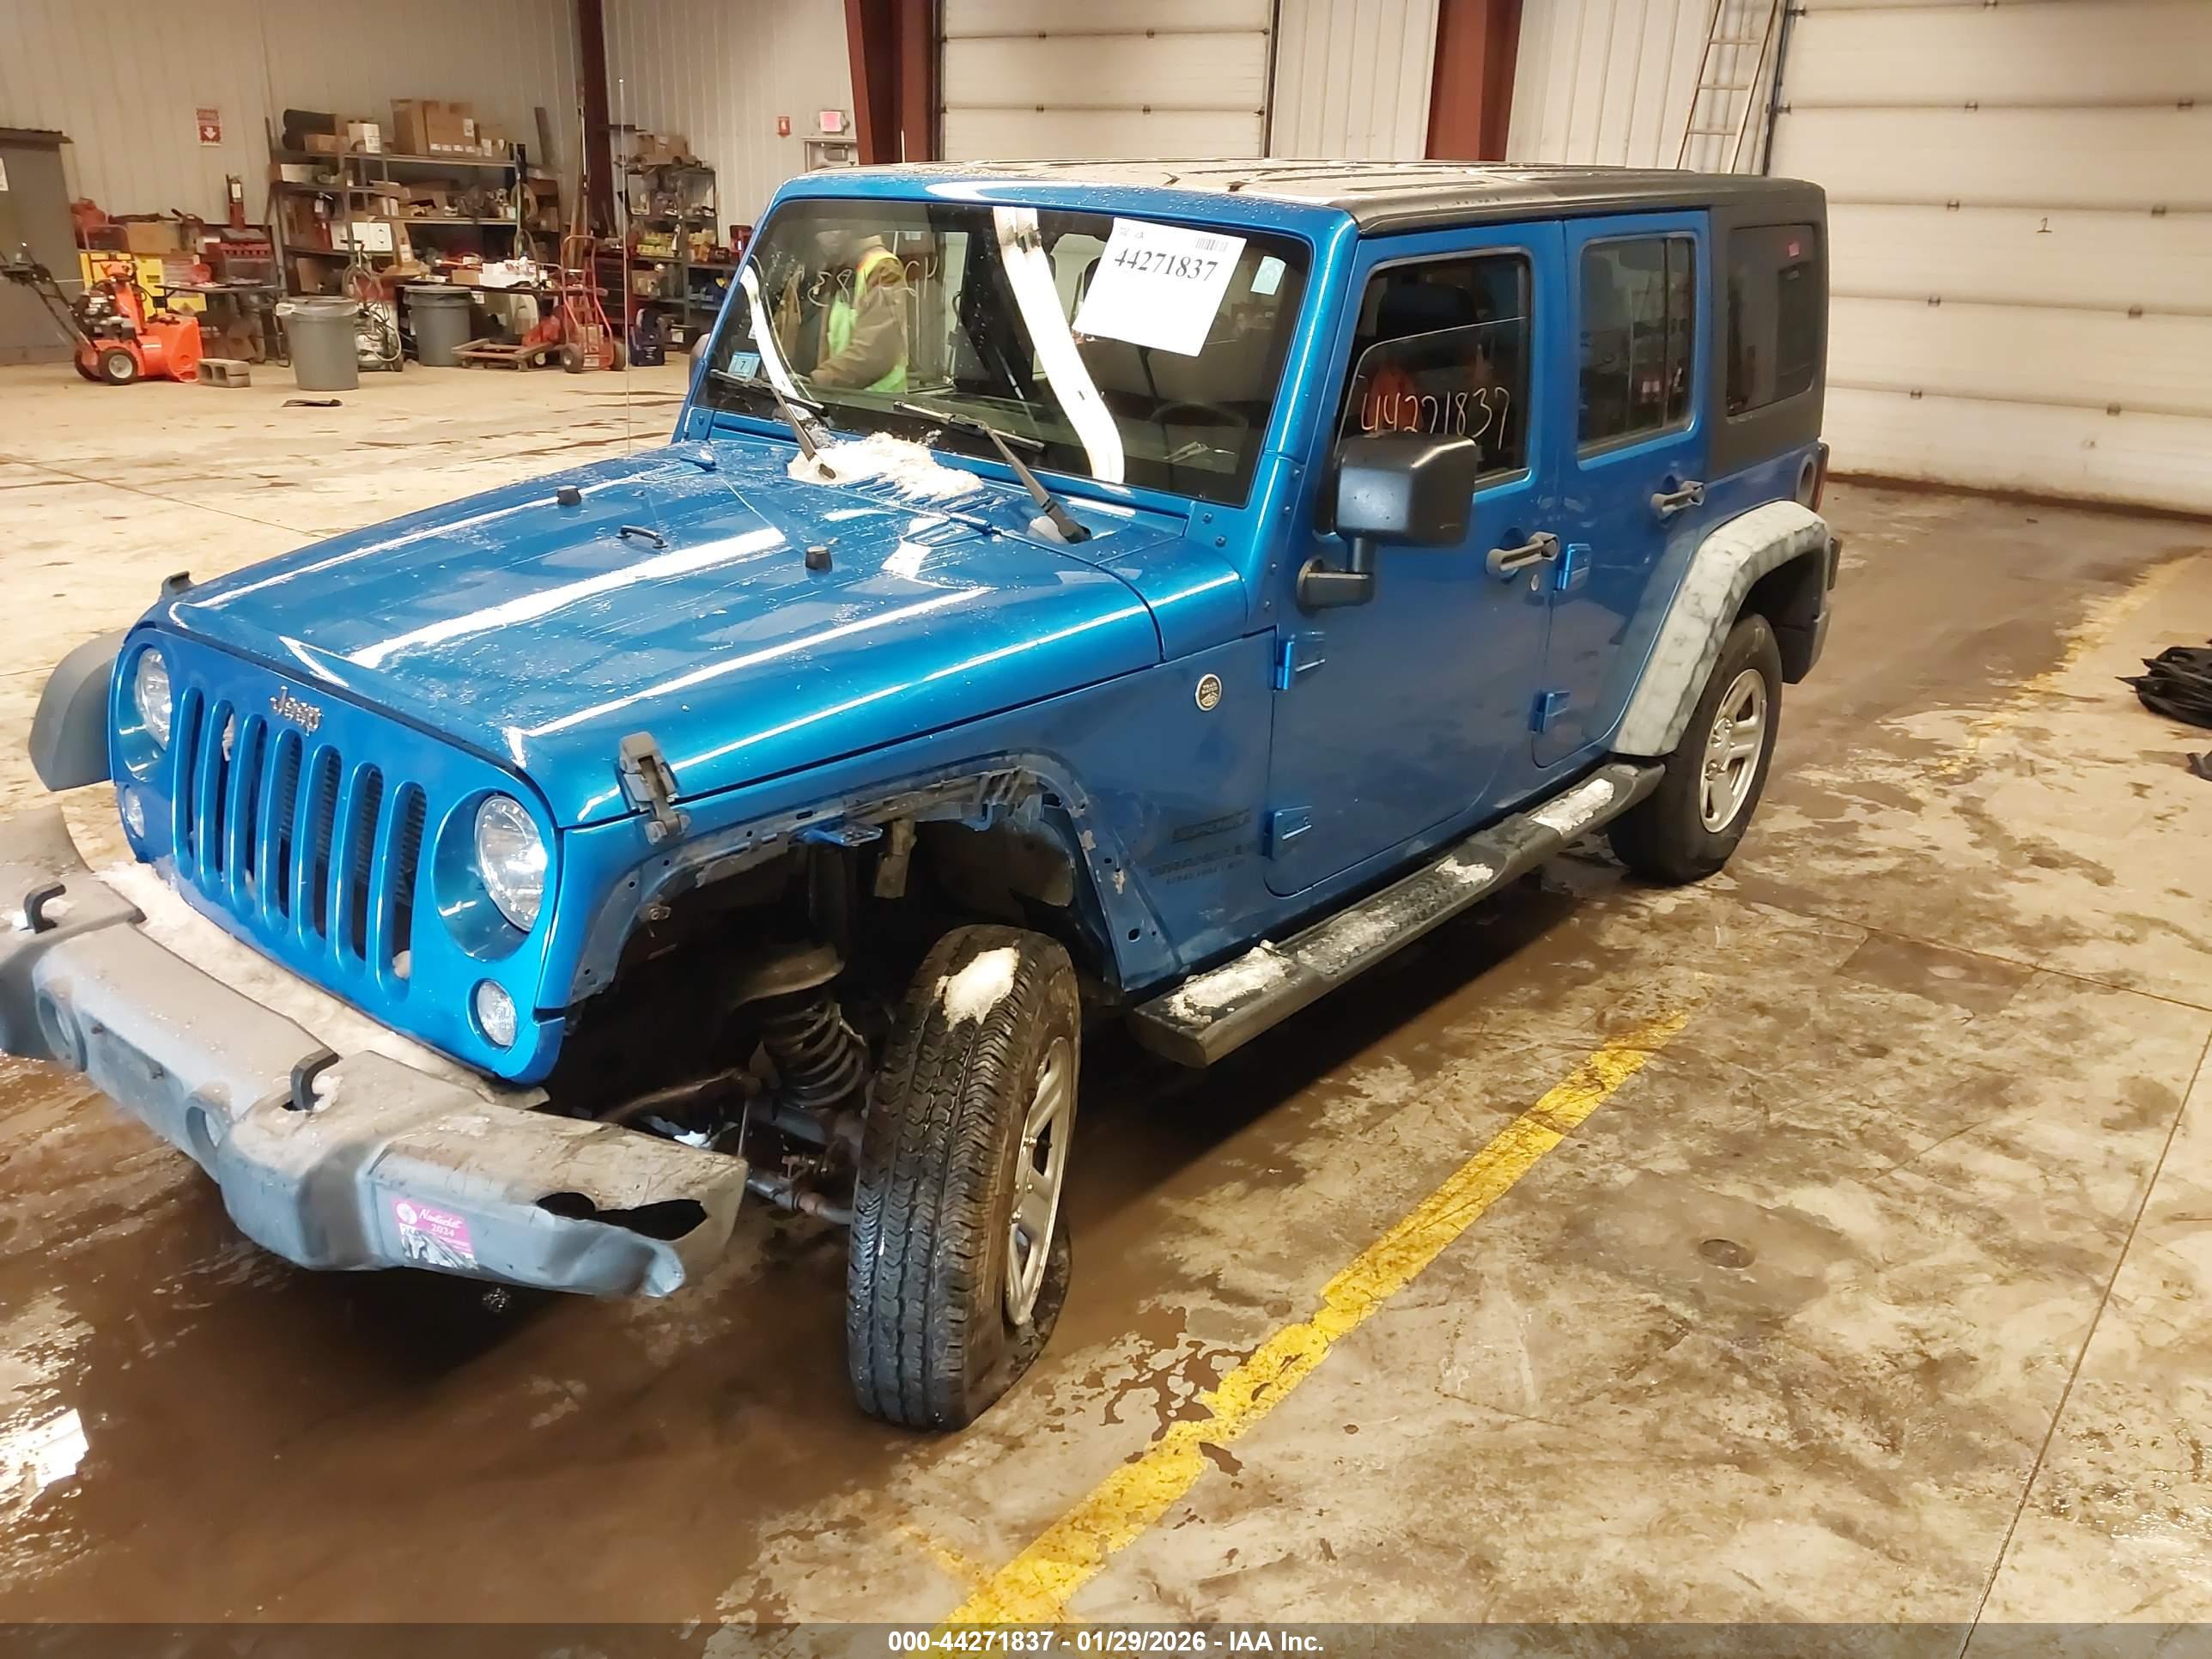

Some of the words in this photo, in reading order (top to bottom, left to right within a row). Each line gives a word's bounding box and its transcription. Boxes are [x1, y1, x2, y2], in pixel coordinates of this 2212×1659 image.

[2037, 217, 2052, 233] 1
[1115, 247, 1218, 282] 44271837
[1361, 386, 1510, 450] 44271837
[270, 685, 323, 737] Jeep
[431, 1223, 455, 1237] 2024
